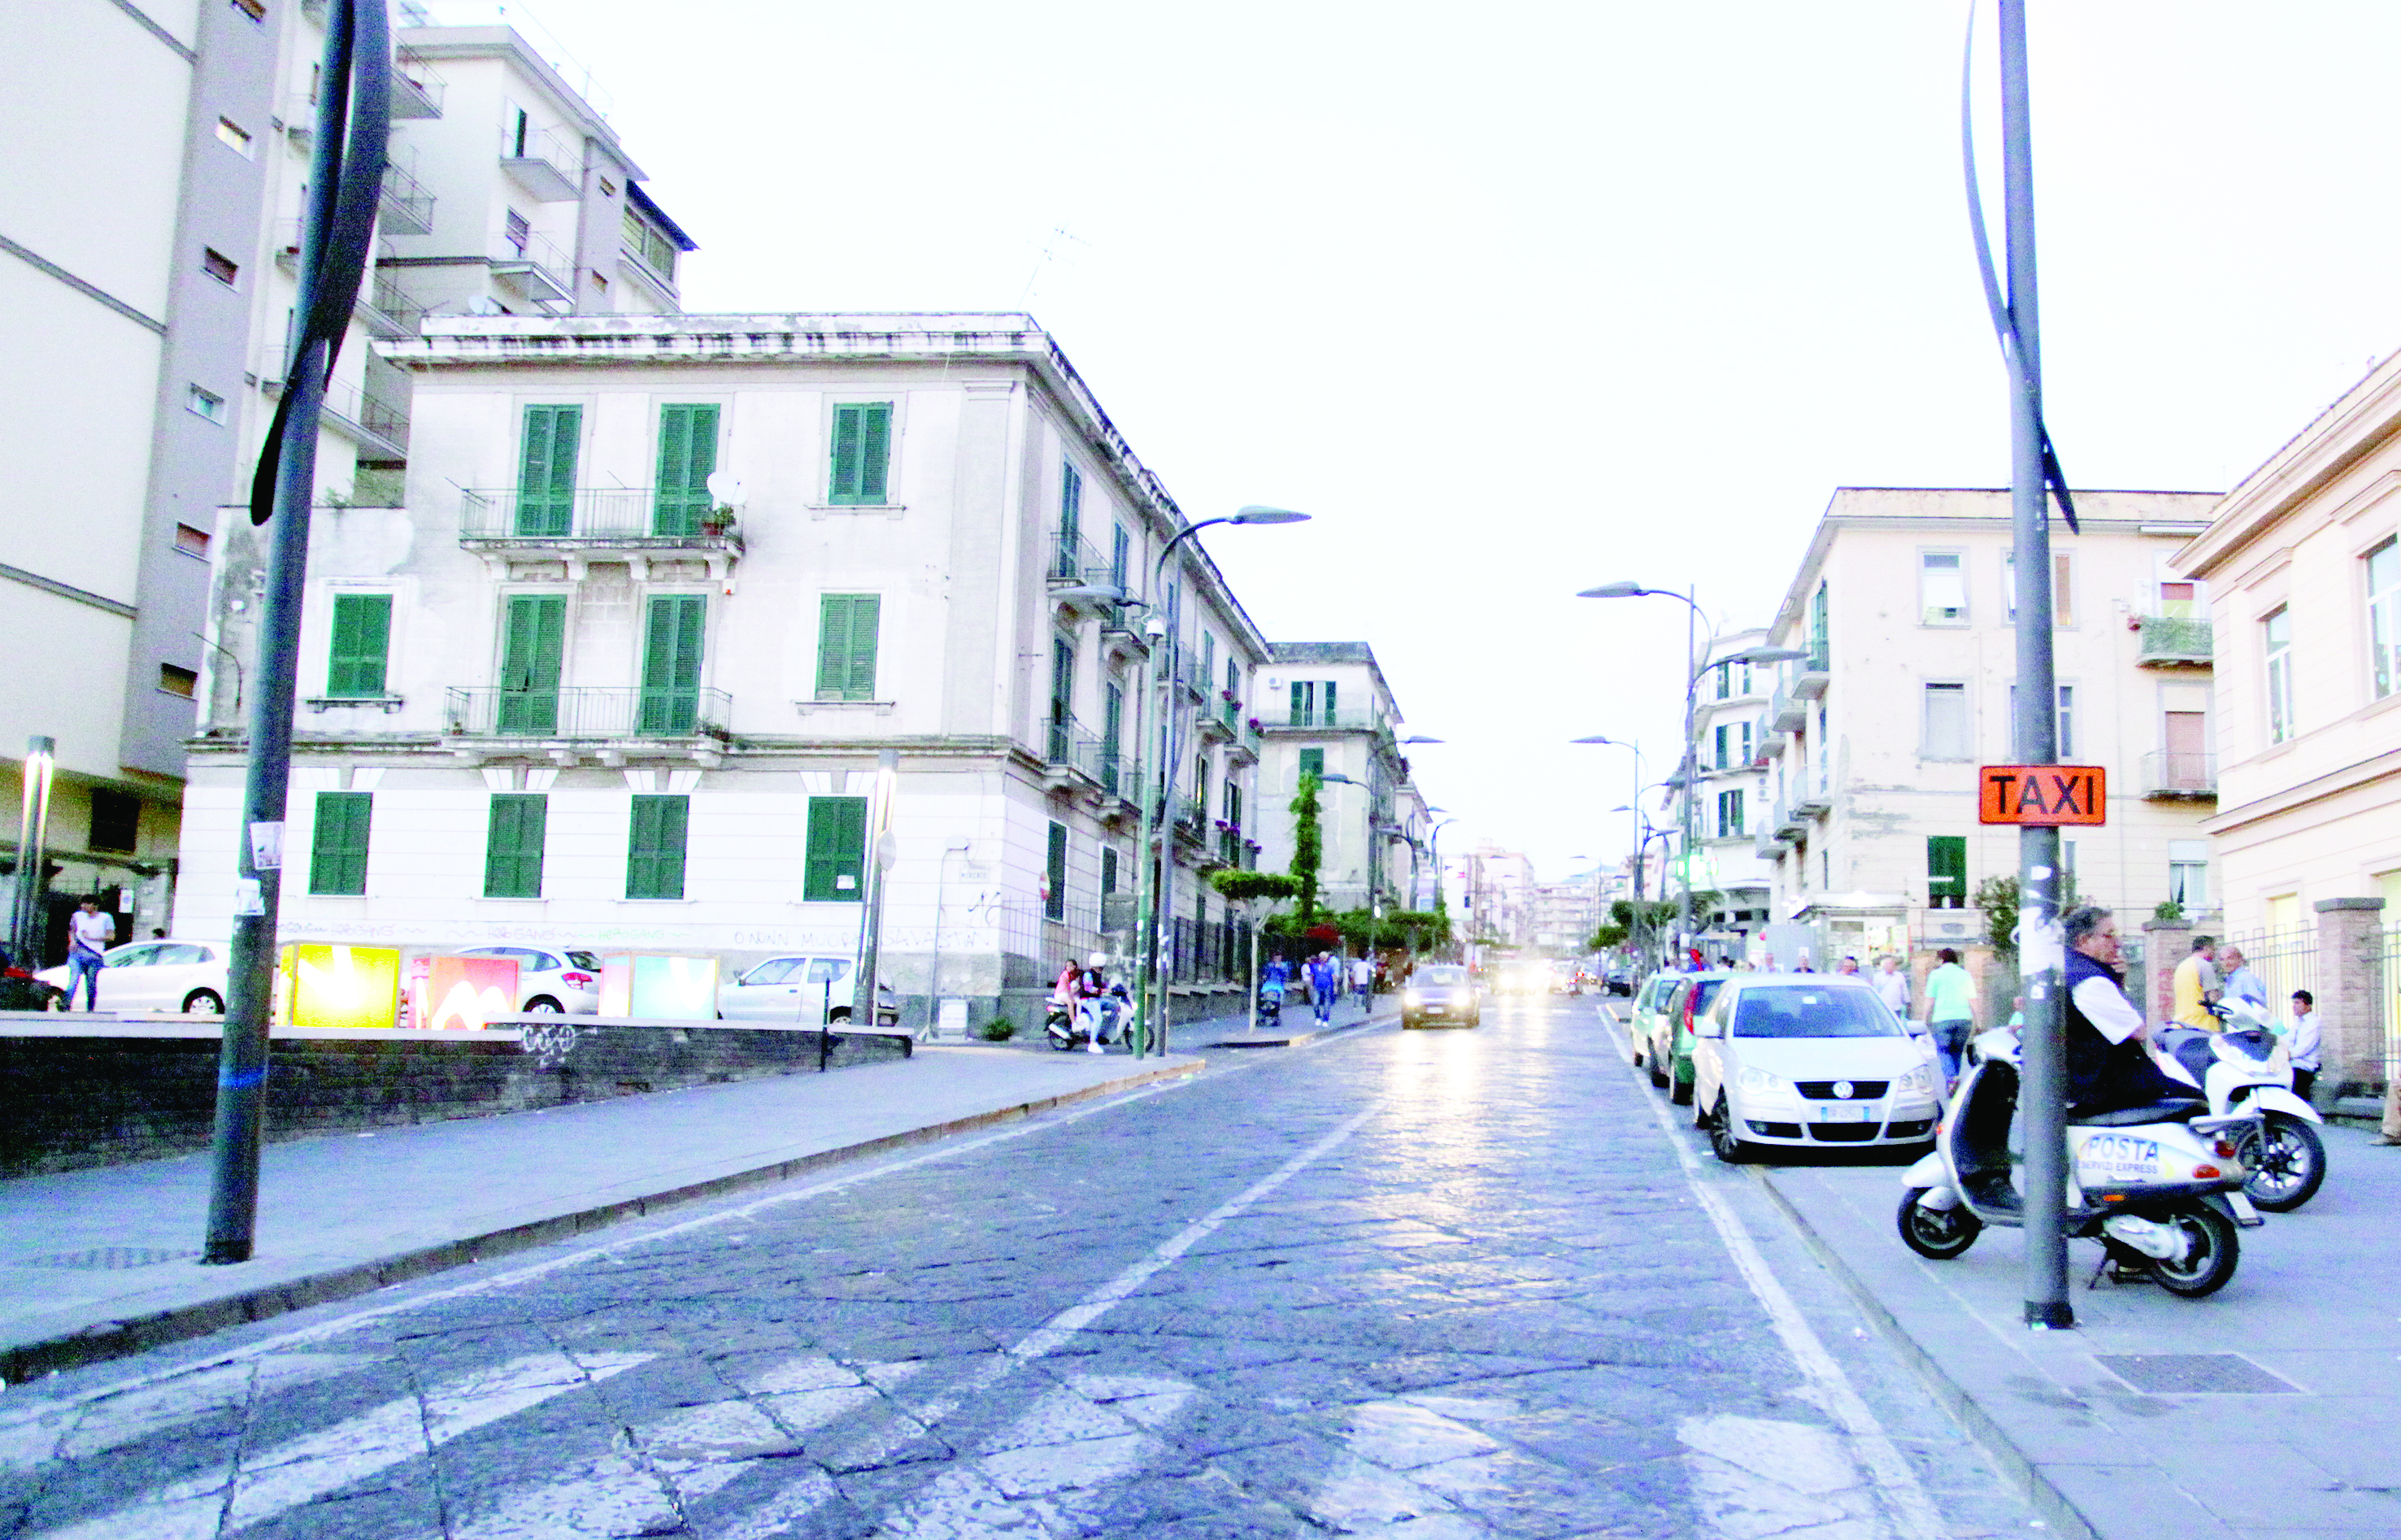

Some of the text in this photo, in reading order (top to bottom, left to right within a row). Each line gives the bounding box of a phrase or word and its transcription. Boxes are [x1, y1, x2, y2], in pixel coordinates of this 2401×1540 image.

[1990, 776, 2094, 815] TAXI
[2087, 1137, 2159, 1161] POSTA
[2116, 1163, 2159, 1174] EXPRESS
